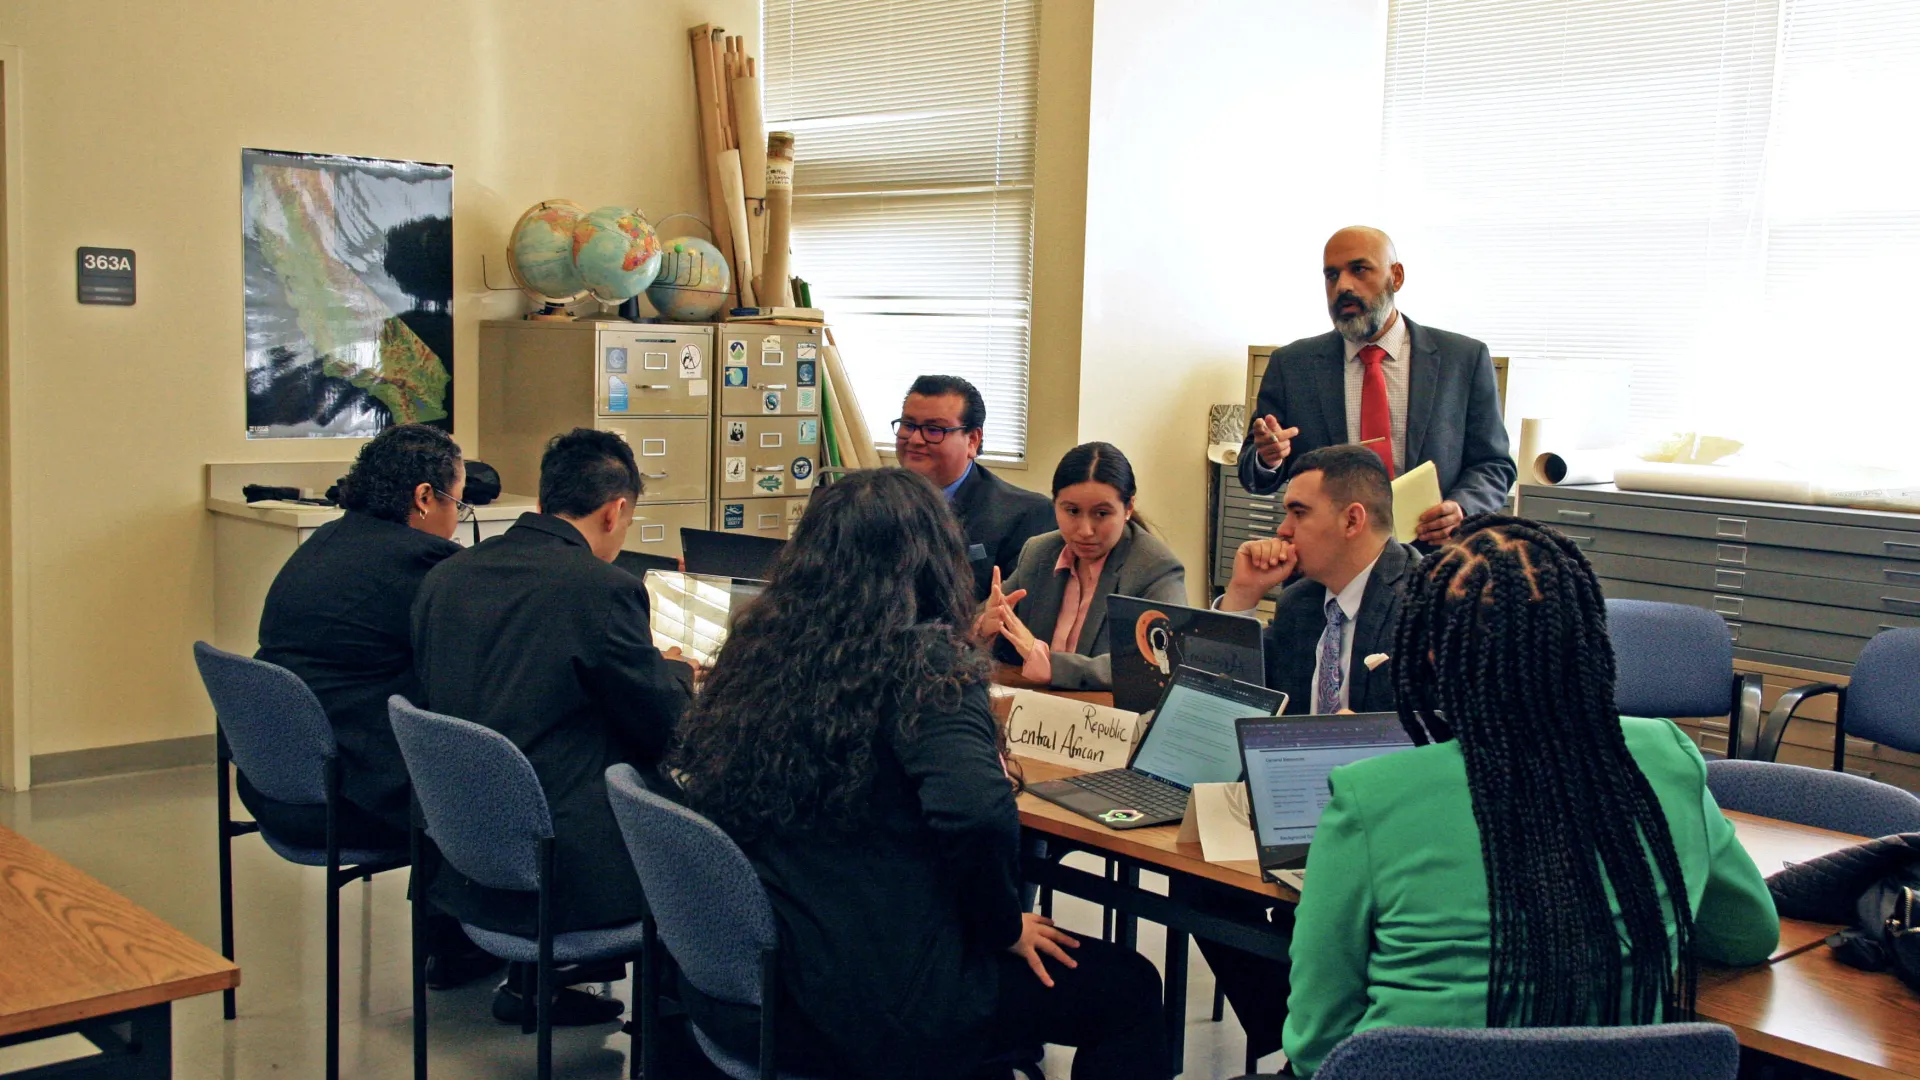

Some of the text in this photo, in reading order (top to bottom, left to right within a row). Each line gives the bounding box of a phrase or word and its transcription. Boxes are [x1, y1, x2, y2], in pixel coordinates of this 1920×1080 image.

[84, 254, 131, 271] 363A
[1008, 705, 1057, 751] Central
[1060, 723, 1105, 763] African
[1083, 704, 1128, 742] Republic
